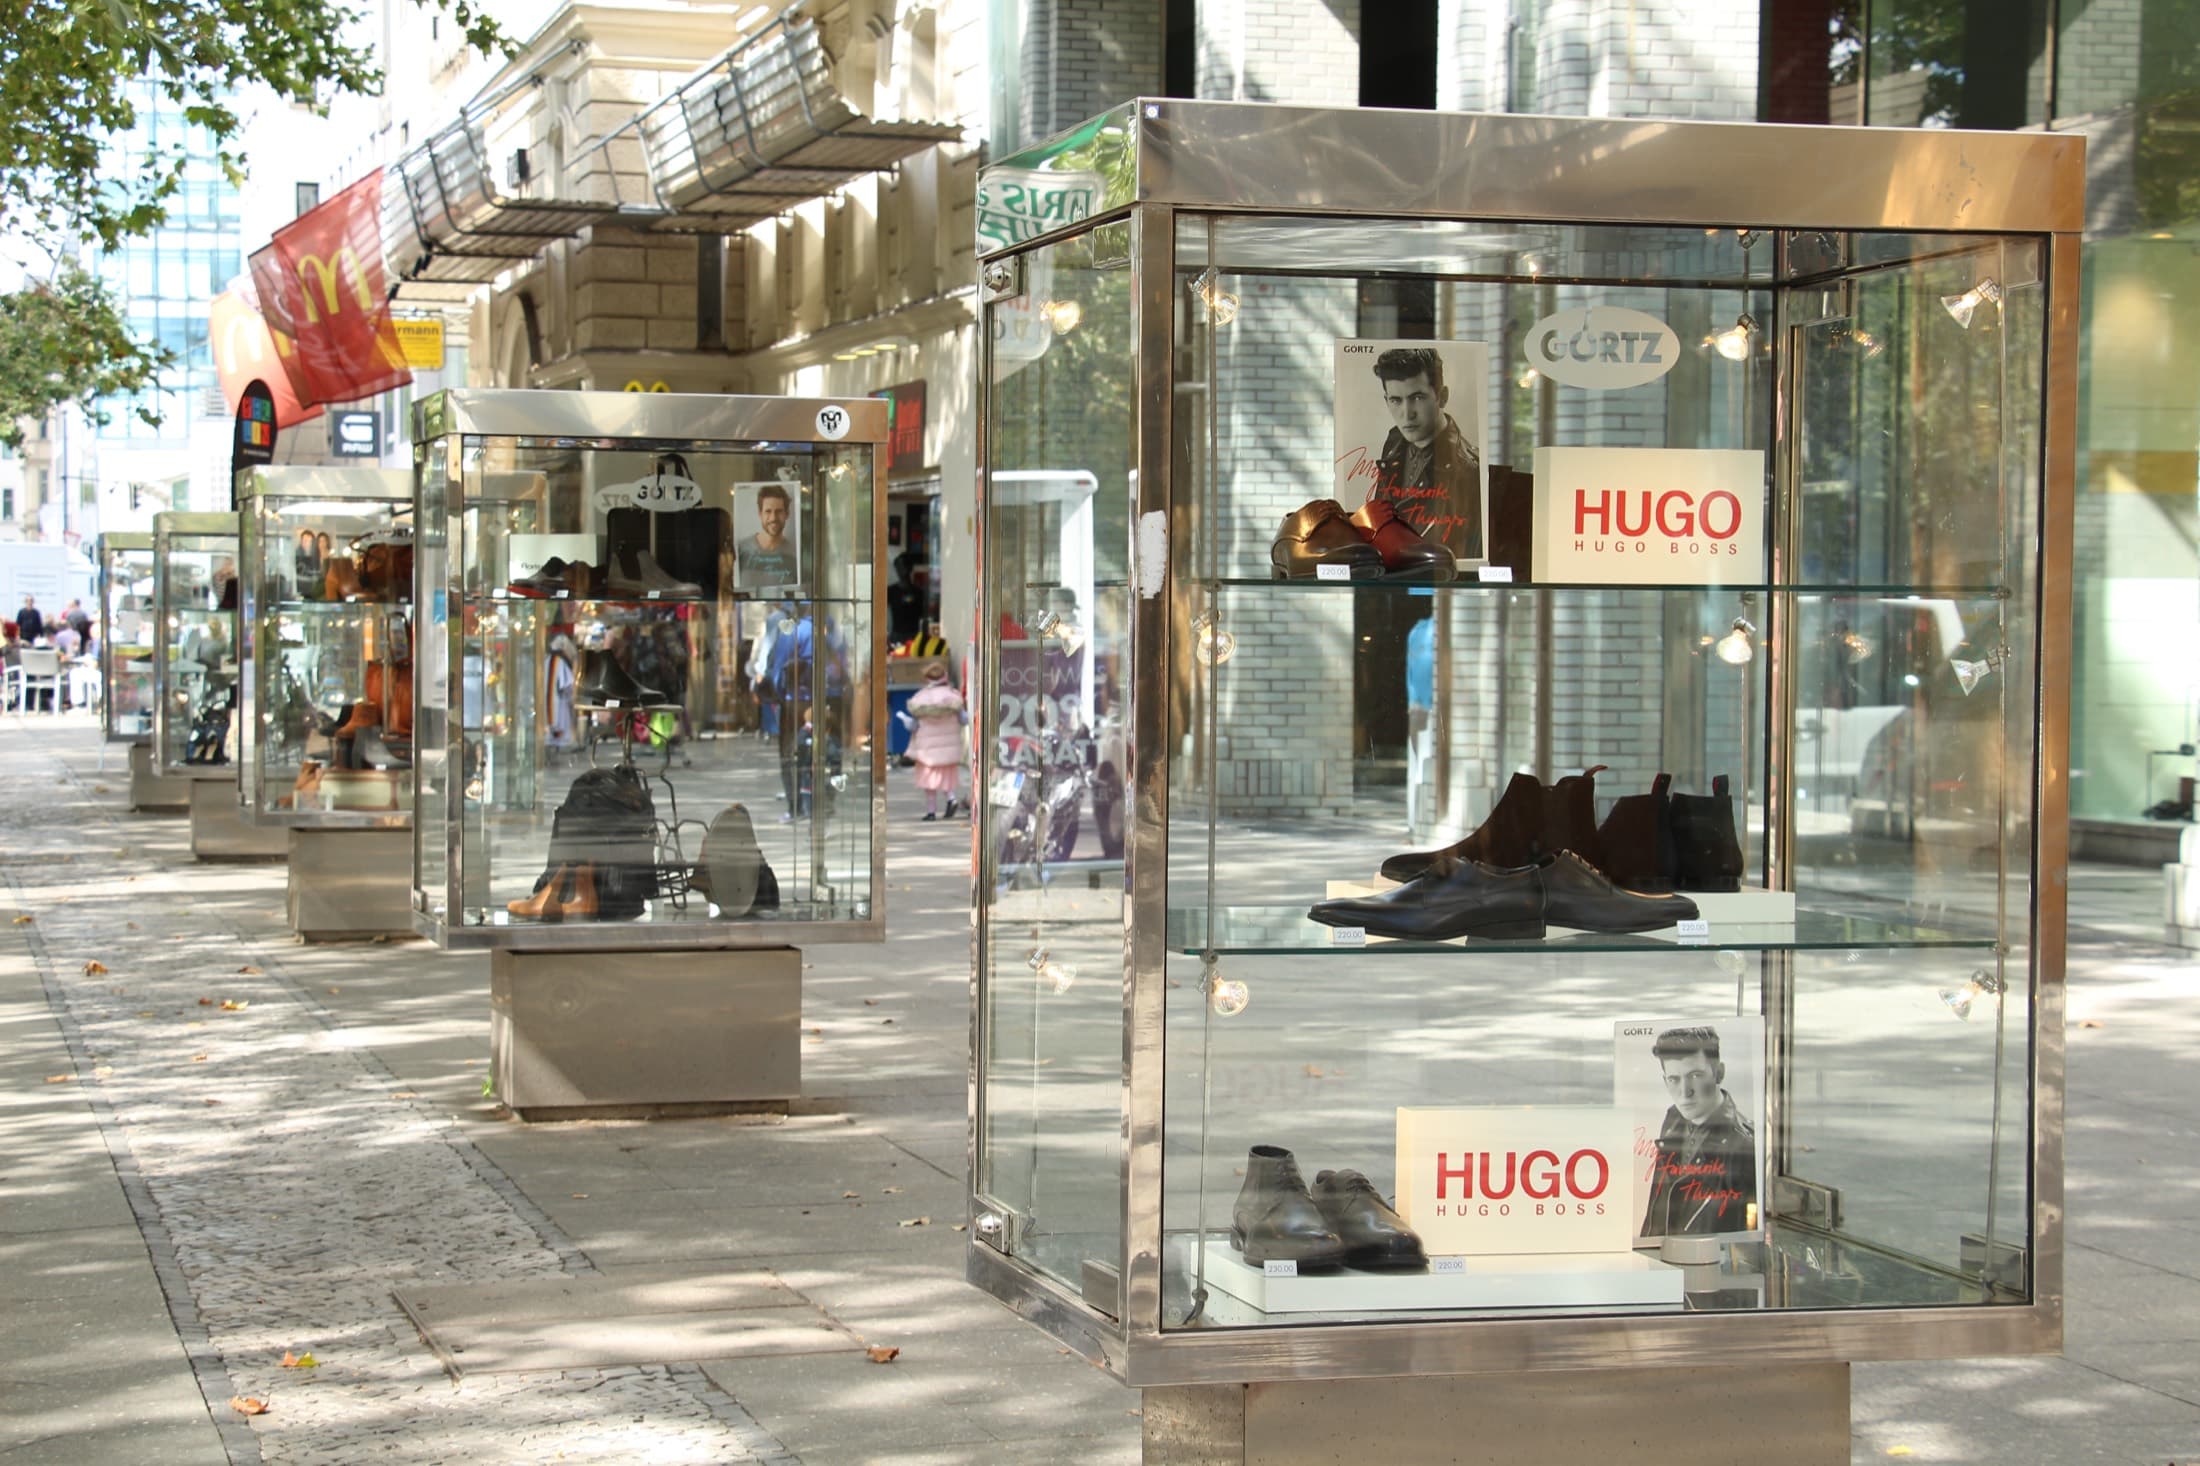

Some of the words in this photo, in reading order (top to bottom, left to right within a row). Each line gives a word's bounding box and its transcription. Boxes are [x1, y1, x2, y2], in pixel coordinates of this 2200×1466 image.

[1343, 343, 1375, 354] GÖRTZ
[1335, 446, 1384, 503] My
[1574, 488, 1742, 540] HUGO
[1575, 540, 1646, 553] HUGO
[1670, 543, 1738, 555] BOSS
[1437, 1149, 1609, 1200] HUGO
[1437, 1204, 1510, 1216] HUGO
[1535, 1203, 1606, 1216] BOSS
[1680, 1178, 1743, 1217] Things
